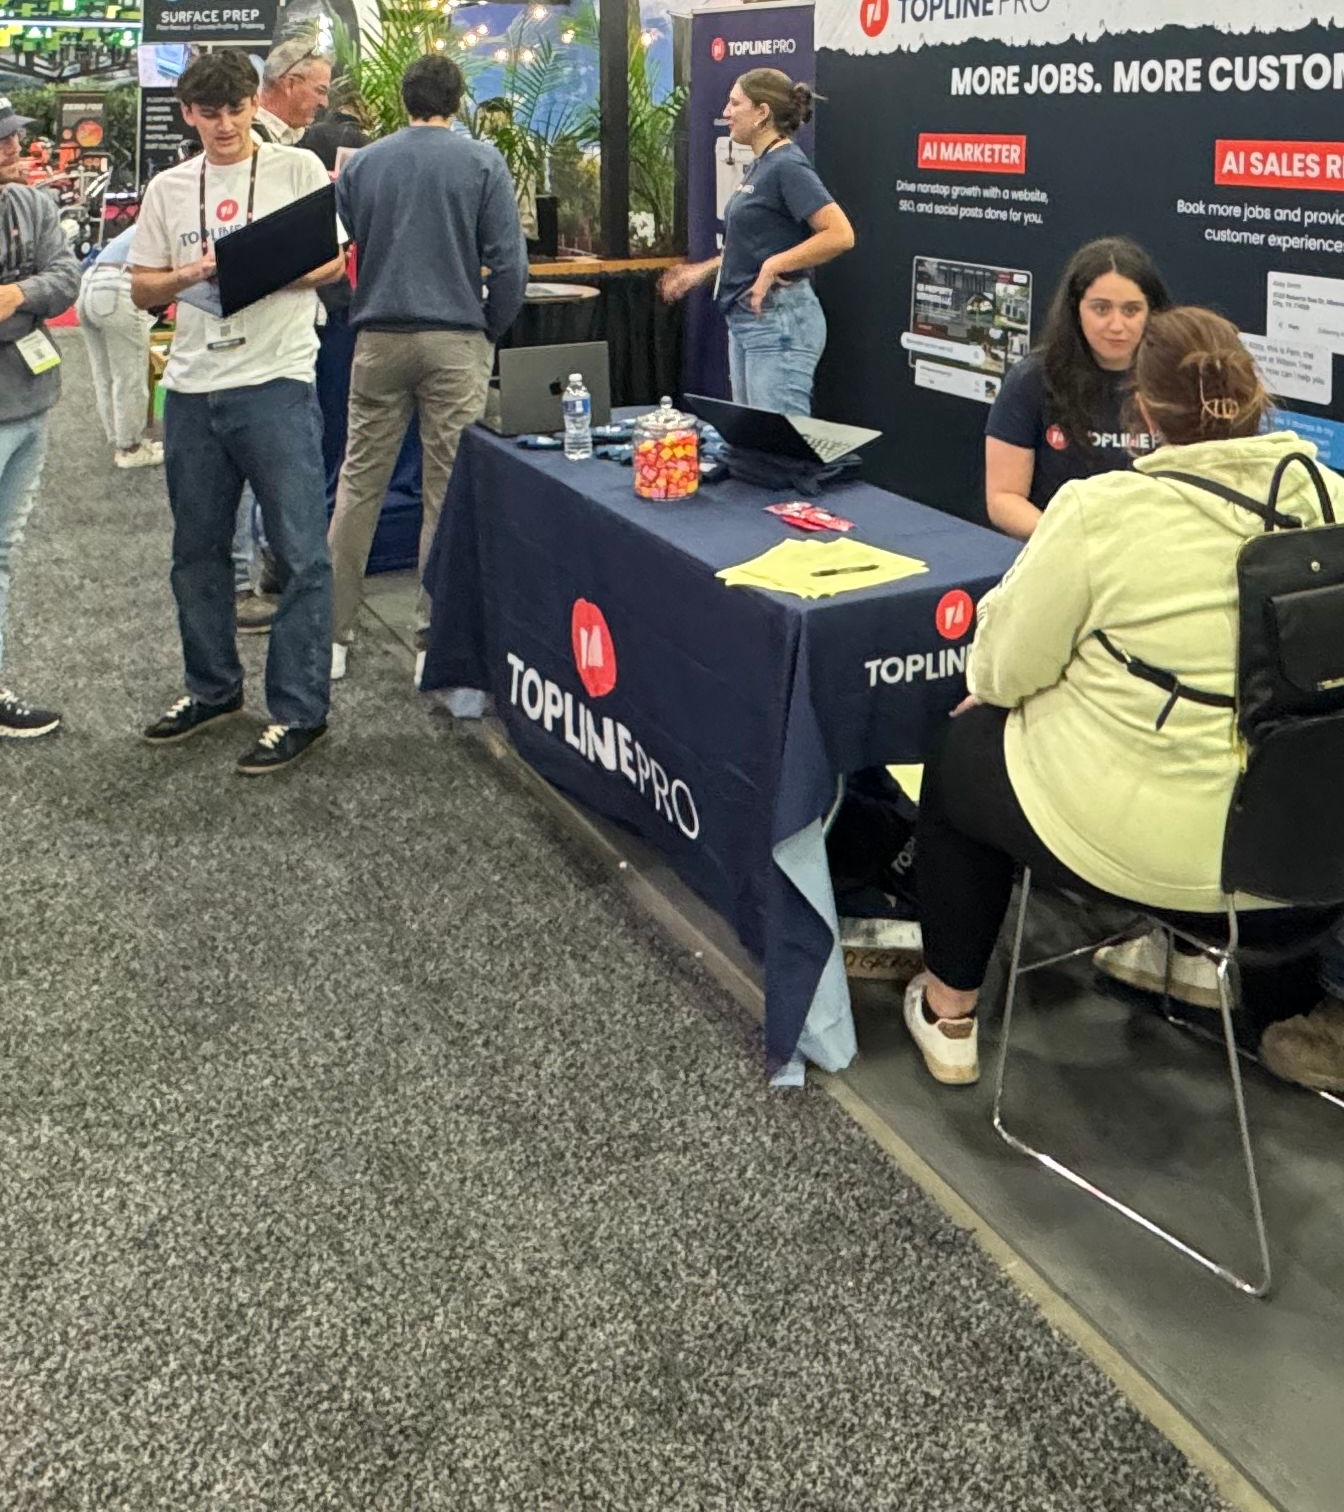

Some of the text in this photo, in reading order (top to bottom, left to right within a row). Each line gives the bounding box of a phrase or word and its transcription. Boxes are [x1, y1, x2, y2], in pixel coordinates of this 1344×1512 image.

[161, 9, 260, 24] SURFACE PREP
[951, 65, 1020, 96] MORE
[1023, 62, 1102, 95] JOBS.
[1113, 58, 1202, 93] MORE
[922, 142, 1021, 165] AI MARKETER
[1221, 150, 1245, 175] AI
[1249, 151, 1320, 178] SALES
[896, 180, 1049, 205] Drive nonstop growth with a website,
[916, 202, 933, 214] and
[934, 203, 958, 216] social
[959, 207, 983, 220] posts
[984, 207, 1007, 221] done
[1009, 208, 1022, 223] for
[1176, 199, 1206, 215] Book
[1208, 203, 1241, 217] more
[1243, 202, 1271, 222] jobs
[1273, 206, 1301, 222] and
[1204, 227, 1264, 246] customer
